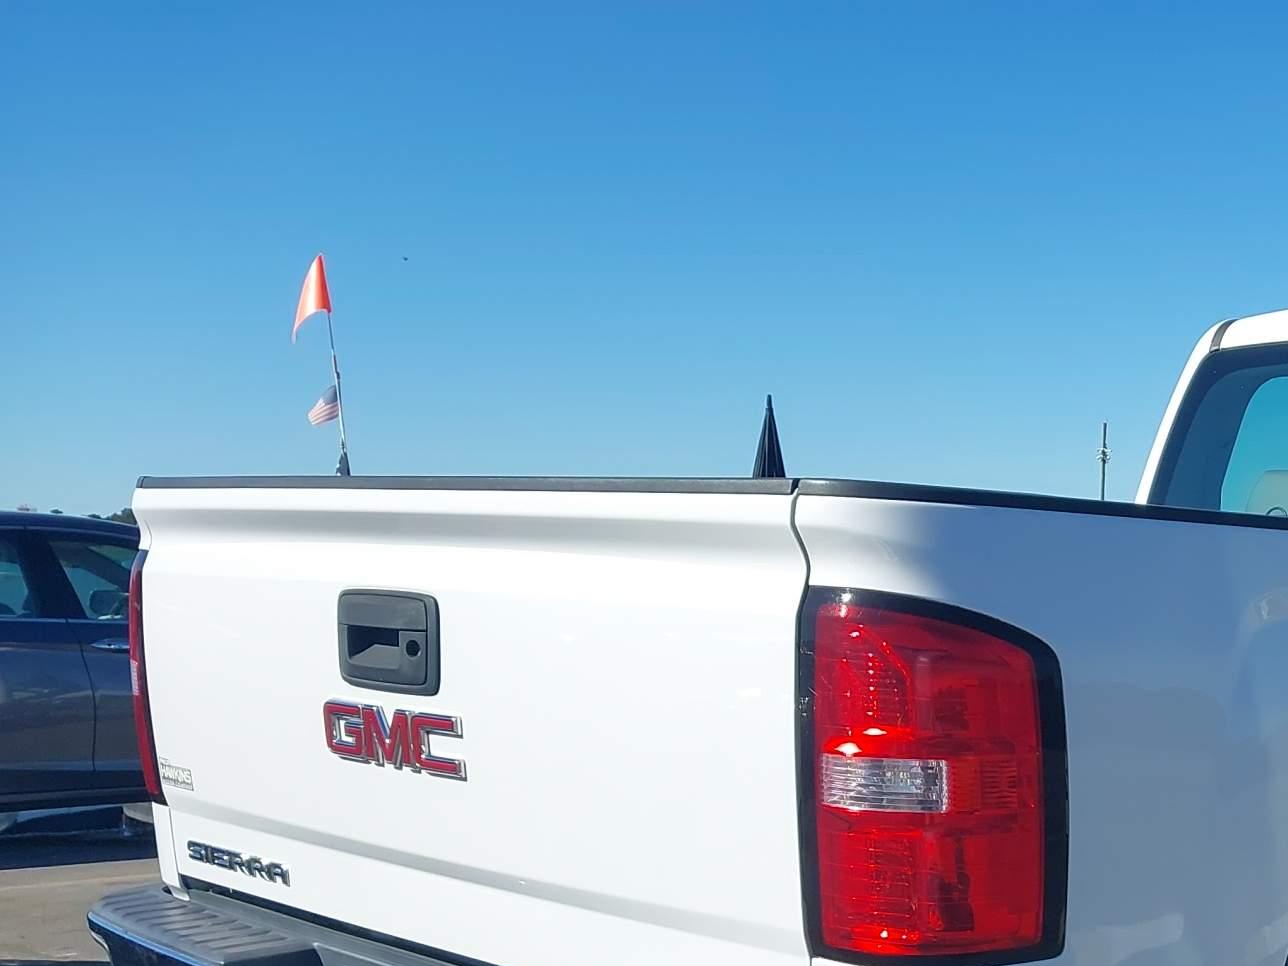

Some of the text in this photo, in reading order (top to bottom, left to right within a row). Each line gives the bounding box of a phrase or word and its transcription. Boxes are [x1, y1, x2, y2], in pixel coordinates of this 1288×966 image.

[323, 697, 468, 781] GMC
[160, 763, 193, 786] HAWKINS
[187, 840, 291, 887] SIERRA
